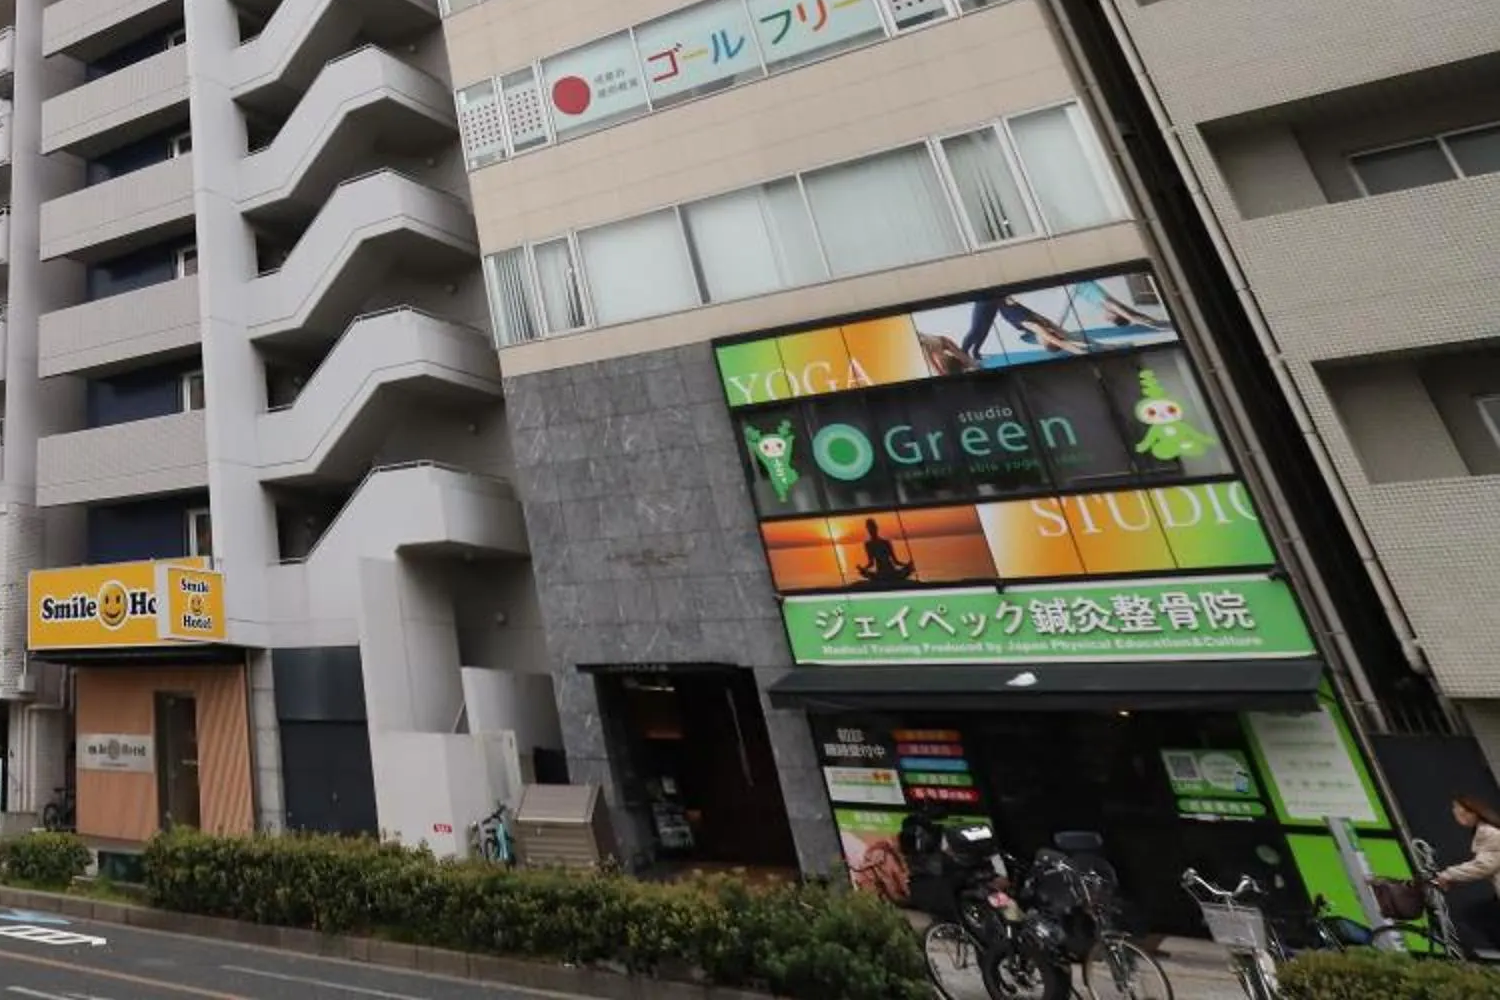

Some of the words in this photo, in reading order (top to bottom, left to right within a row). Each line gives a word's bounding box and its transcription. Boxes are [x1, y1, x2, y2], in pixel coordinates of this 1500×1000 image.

[729, 357, 875, 405] YOGA
[957, 405, 1014, 424] studio
[883, 415, 1078, 465] Green
[41, 595, 97, 620] Smile
[815, 589, 1256, 641] ジェイペック鍼灸整骨院
